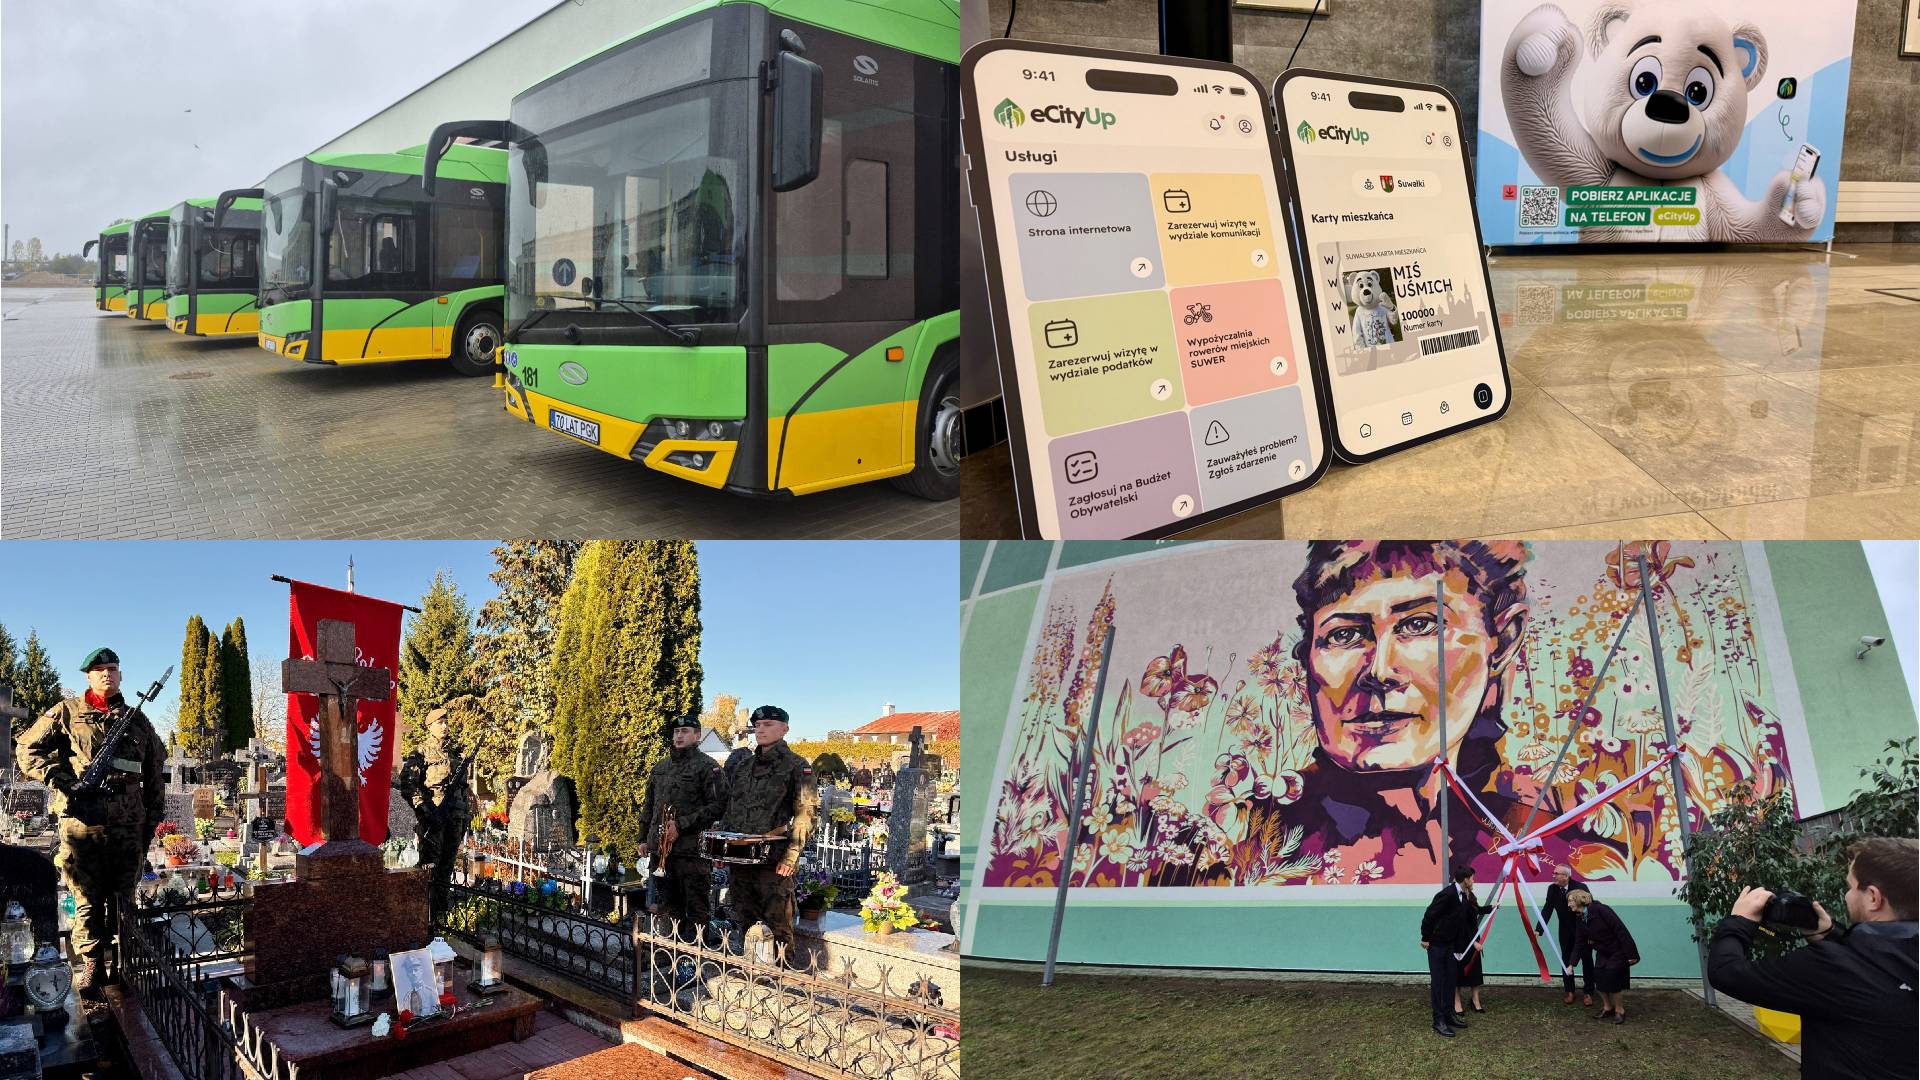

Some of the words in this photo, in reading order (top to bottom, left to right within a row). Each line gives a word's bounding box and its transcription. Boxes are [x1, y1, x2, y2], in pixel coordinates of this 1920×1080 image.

[1022, 69, 1056, 82] 9:41
[1310, 91, 1331, 102] 9:41
[1030, 105, 1117, 130] eCityUp
[1318, 125, 1370, 145] eCityUp
[1005, 150, 1058, 165] Usługi
[1397, 179, 1425, 188] Suwałki
[1571, 190, 1624, 201] POBIERZ
[1626, 190, 1692, 201] APLIKACJE
[1311, 213, 1339, 224] Karty
[1341, 211, 1394, 222] mieszkańca
[1570, 212, 1588, 223] NA
[1591, 211, 1646, 222] TELEFON
[1658, 211, 1696, 222] eCityUp
[1028, 228, 1066, 237] Strona
[1068, 225, 1132, 235] internetowa
[1167, 220, 1218, 230] Zarezerwuj
[1220, 219, 1247, 228] wizytę
[1169, 231, 1209, 242] wydziale
[1211, 228, 1261, 239] komunikacji
[1393, 261, 1422, 280] MIŚ
[1396, 278, 1453, 299] UŚMICH
[1401, 307, 1435, 321] 100000
[1403, 322, 1426, 332] Numer
[1427, 319, 1443, 328] karty
[1187, 330, 1253, 346] Wypożyczalnia
[1189, 344, 1228, 357] rowerów
[1230, 337, 1270, 350] miejskich
[1048, 350, 1111, 369] Zarezerwuj
[1113, 347, 1147, 359] wizytę
[1190, 355, 1226, 369] SUWER
[522, 366, 538, 388] 181
[1050, 366, 1099, 382] wydziale
[1102, 357, 1153, 374] podatków
[555, 414, 565, 430] 70
[566, 418, 579, 434] LAT
[580, 421, 597, 439] PGK
[1207, 445, 1258, 468] Zauważyłeś
[1259, 435, 1298, 454] problem?
[1208, 464, 1234, 479] Zgłoś
[1236, 453, 1277, 471] zdarzenie
[1068, 484, 1117, 506] Zagłosuj
[1119, 482, 1133, 492] na
[1135, 471, 1171, 488] Budżet
[1070, 491, 1138, 519] Obywatelski
